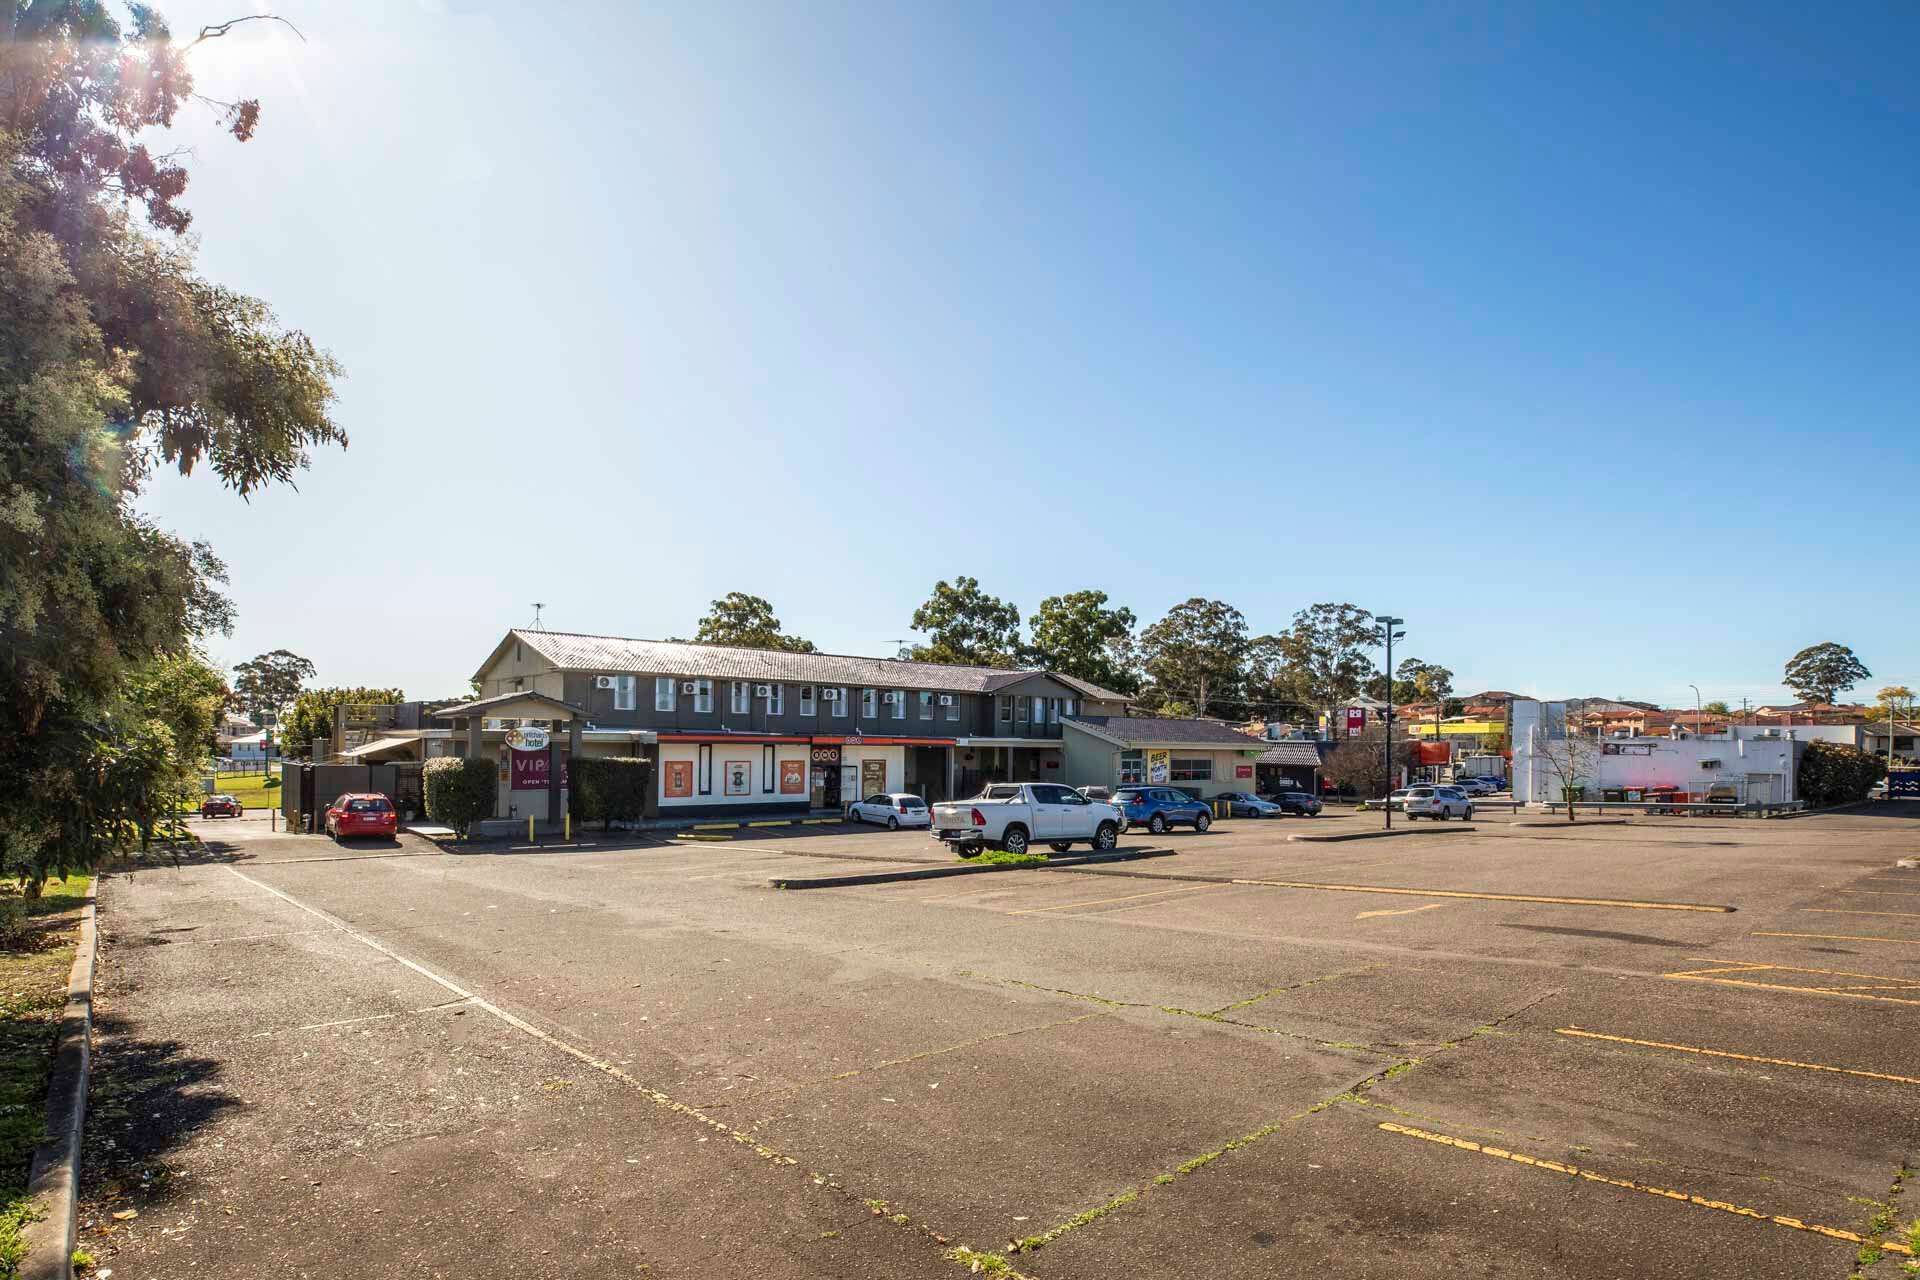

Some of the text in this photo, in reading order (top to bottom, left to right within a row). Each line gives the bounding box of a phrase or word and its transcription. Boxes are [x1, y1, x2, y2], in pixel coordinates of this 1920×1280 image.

[525, 738, 544, 747] hotel
[1151, 752, 1167, 763] BEER
[941, 816, 965, 824] TOYOTA
